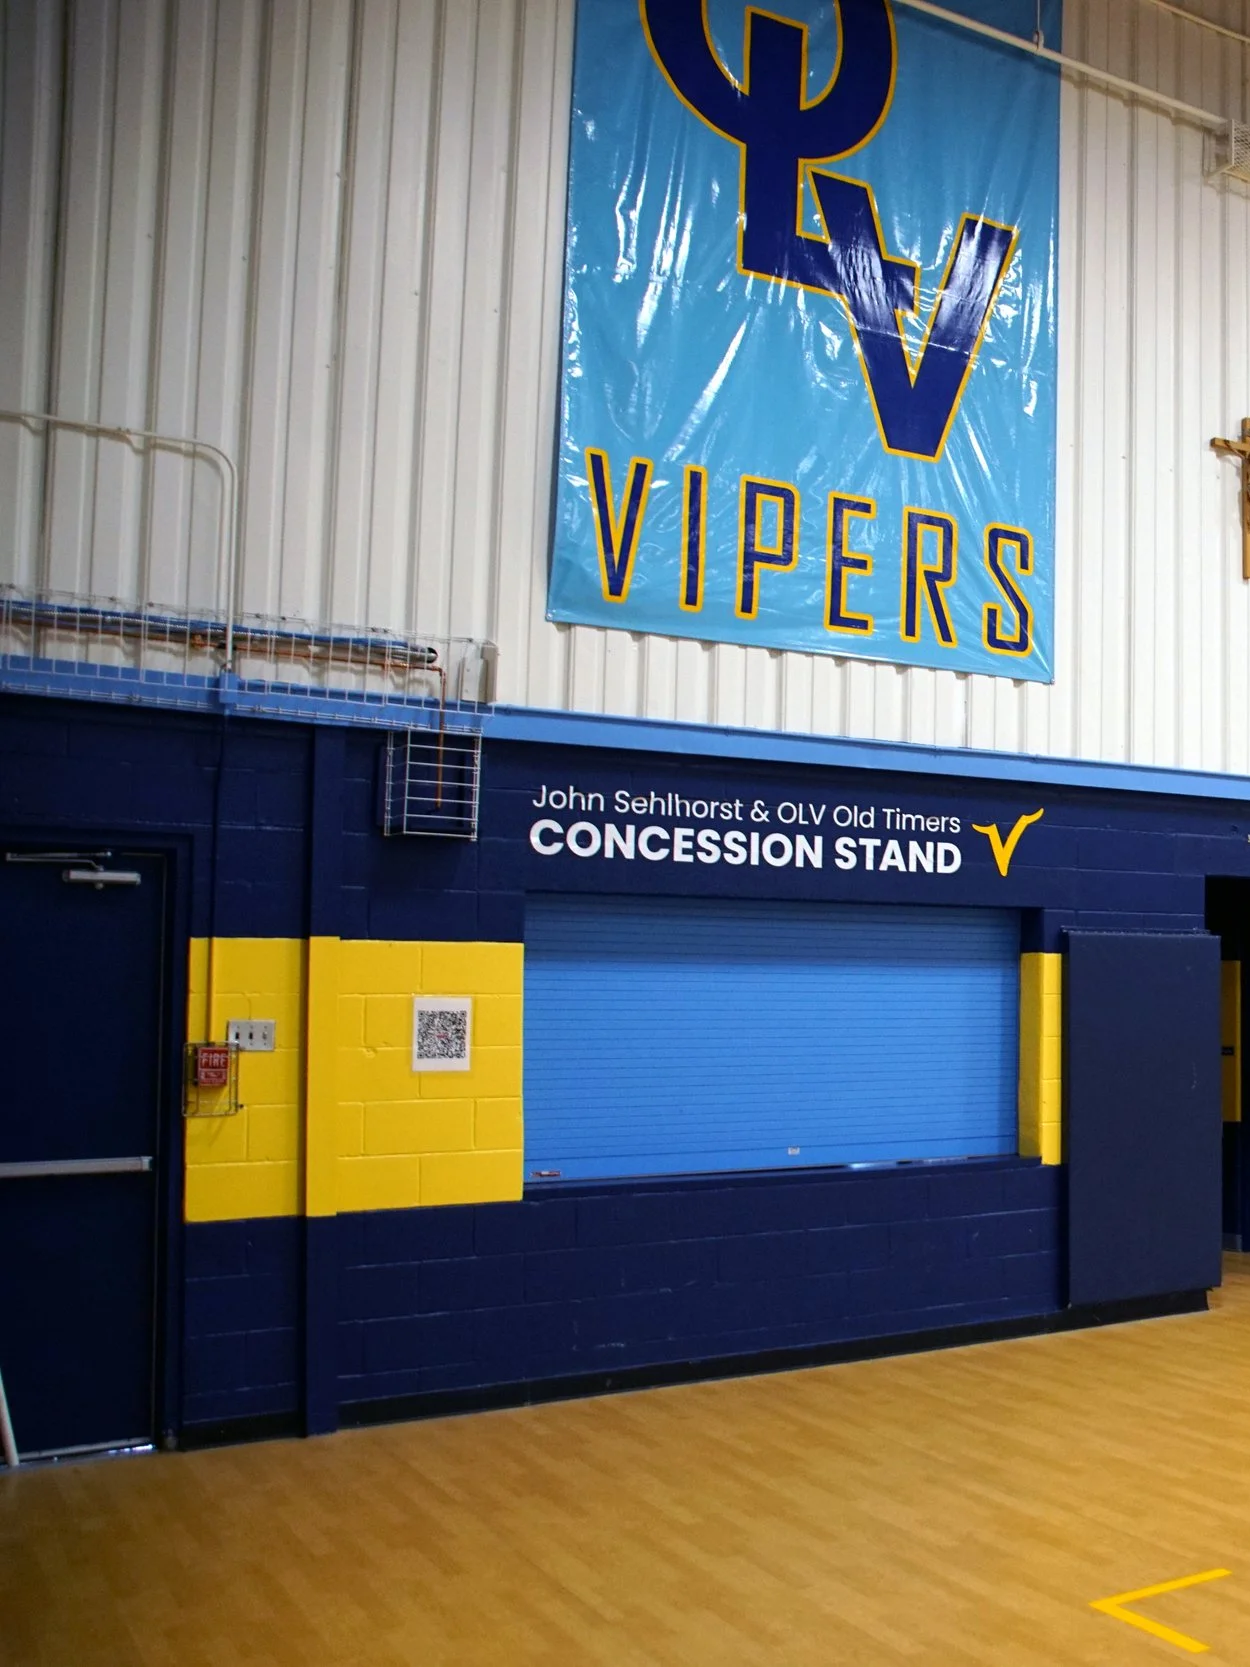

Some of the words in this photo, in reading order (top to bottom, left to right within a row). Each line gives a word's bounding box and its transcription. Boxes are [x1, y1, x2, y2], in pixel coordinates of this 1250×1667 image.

[585, 447, 1033, 658] VIPERS
[532, 784, 604, 812] John
[614, 791, 744, 821] Sehlhorst
[750, 801, 770, 823] &
[777, 803, 826, 826] OLV
[833, 805, 876, 828] Old
[882, 807, 961, 833] Timers
[529, 818, 823, 868] CONCESSION
[834, 838, 962, 874] STAND
[200, 1052, 227, 1068] FIRE
